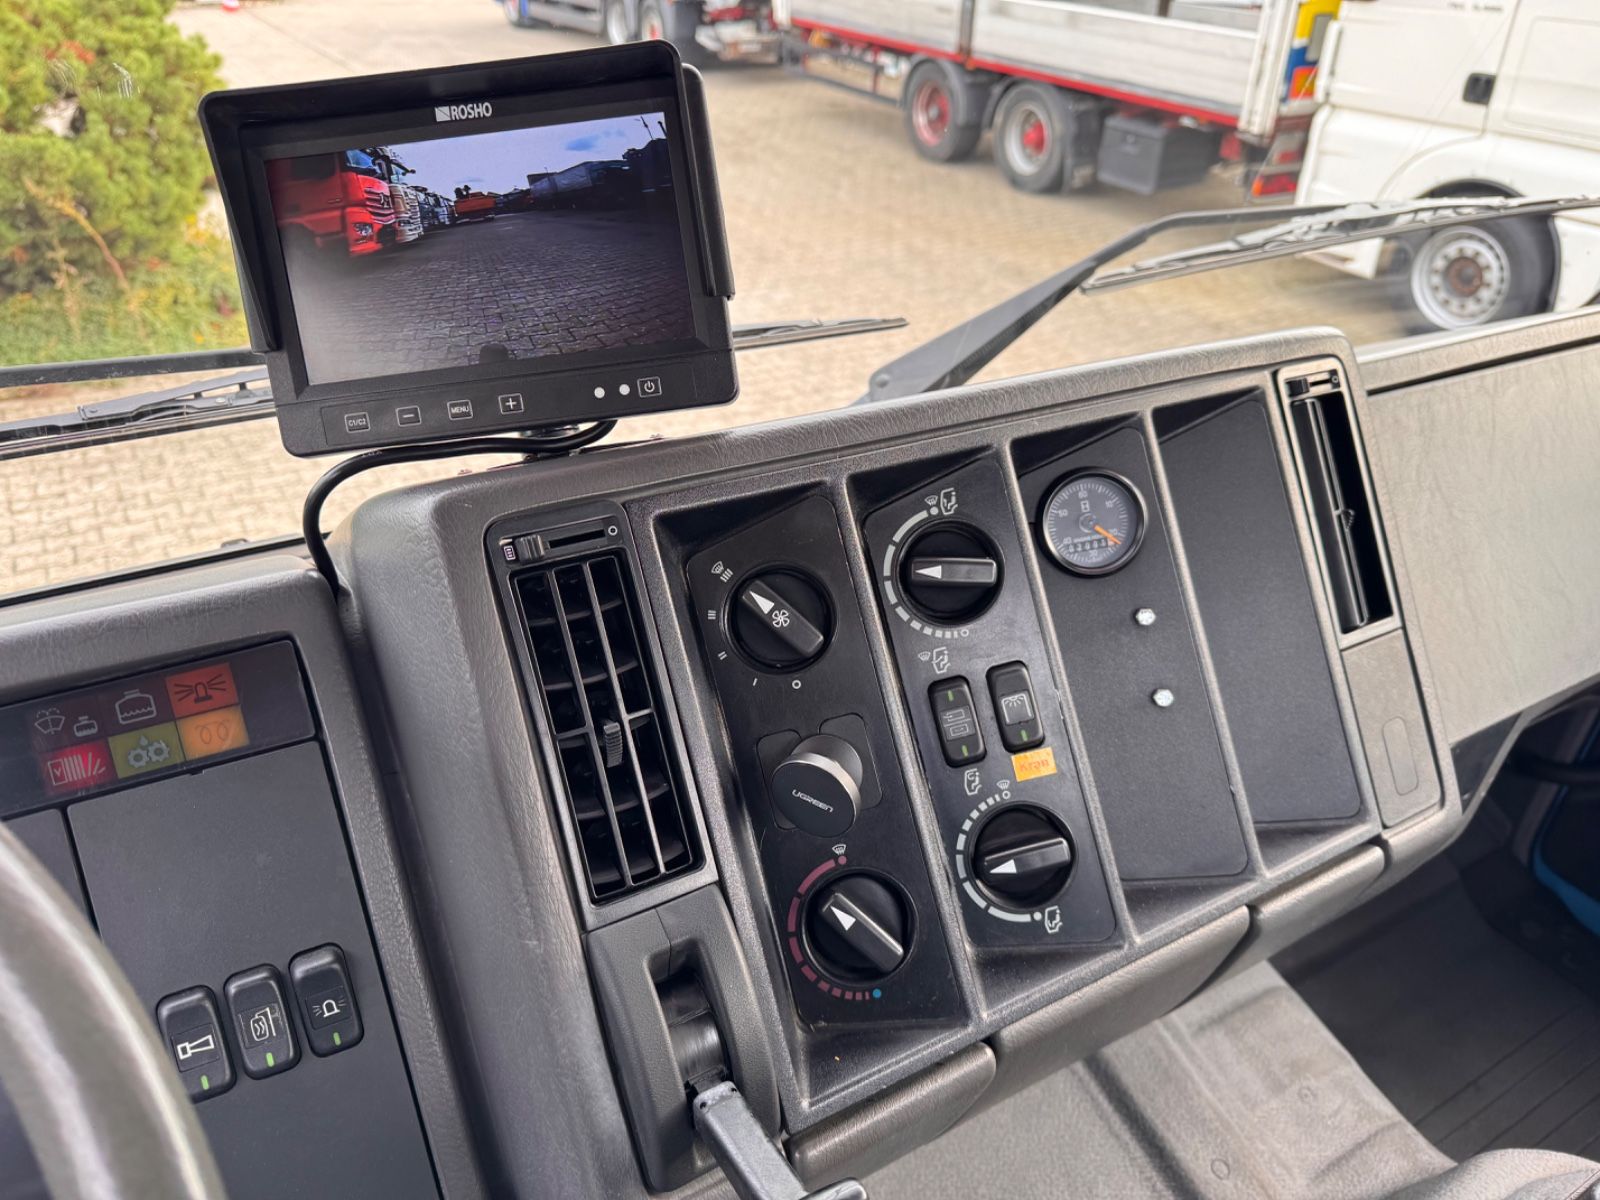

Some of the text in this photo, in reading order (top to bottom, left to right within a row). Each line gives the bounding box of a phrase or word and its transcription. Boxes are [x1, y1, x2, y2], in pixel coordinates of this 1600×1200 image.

[450, 102, 492, 120] ROSHO
[450, 405, 470, 414] MENU
[791, 789, 834, 813] UGREEN
